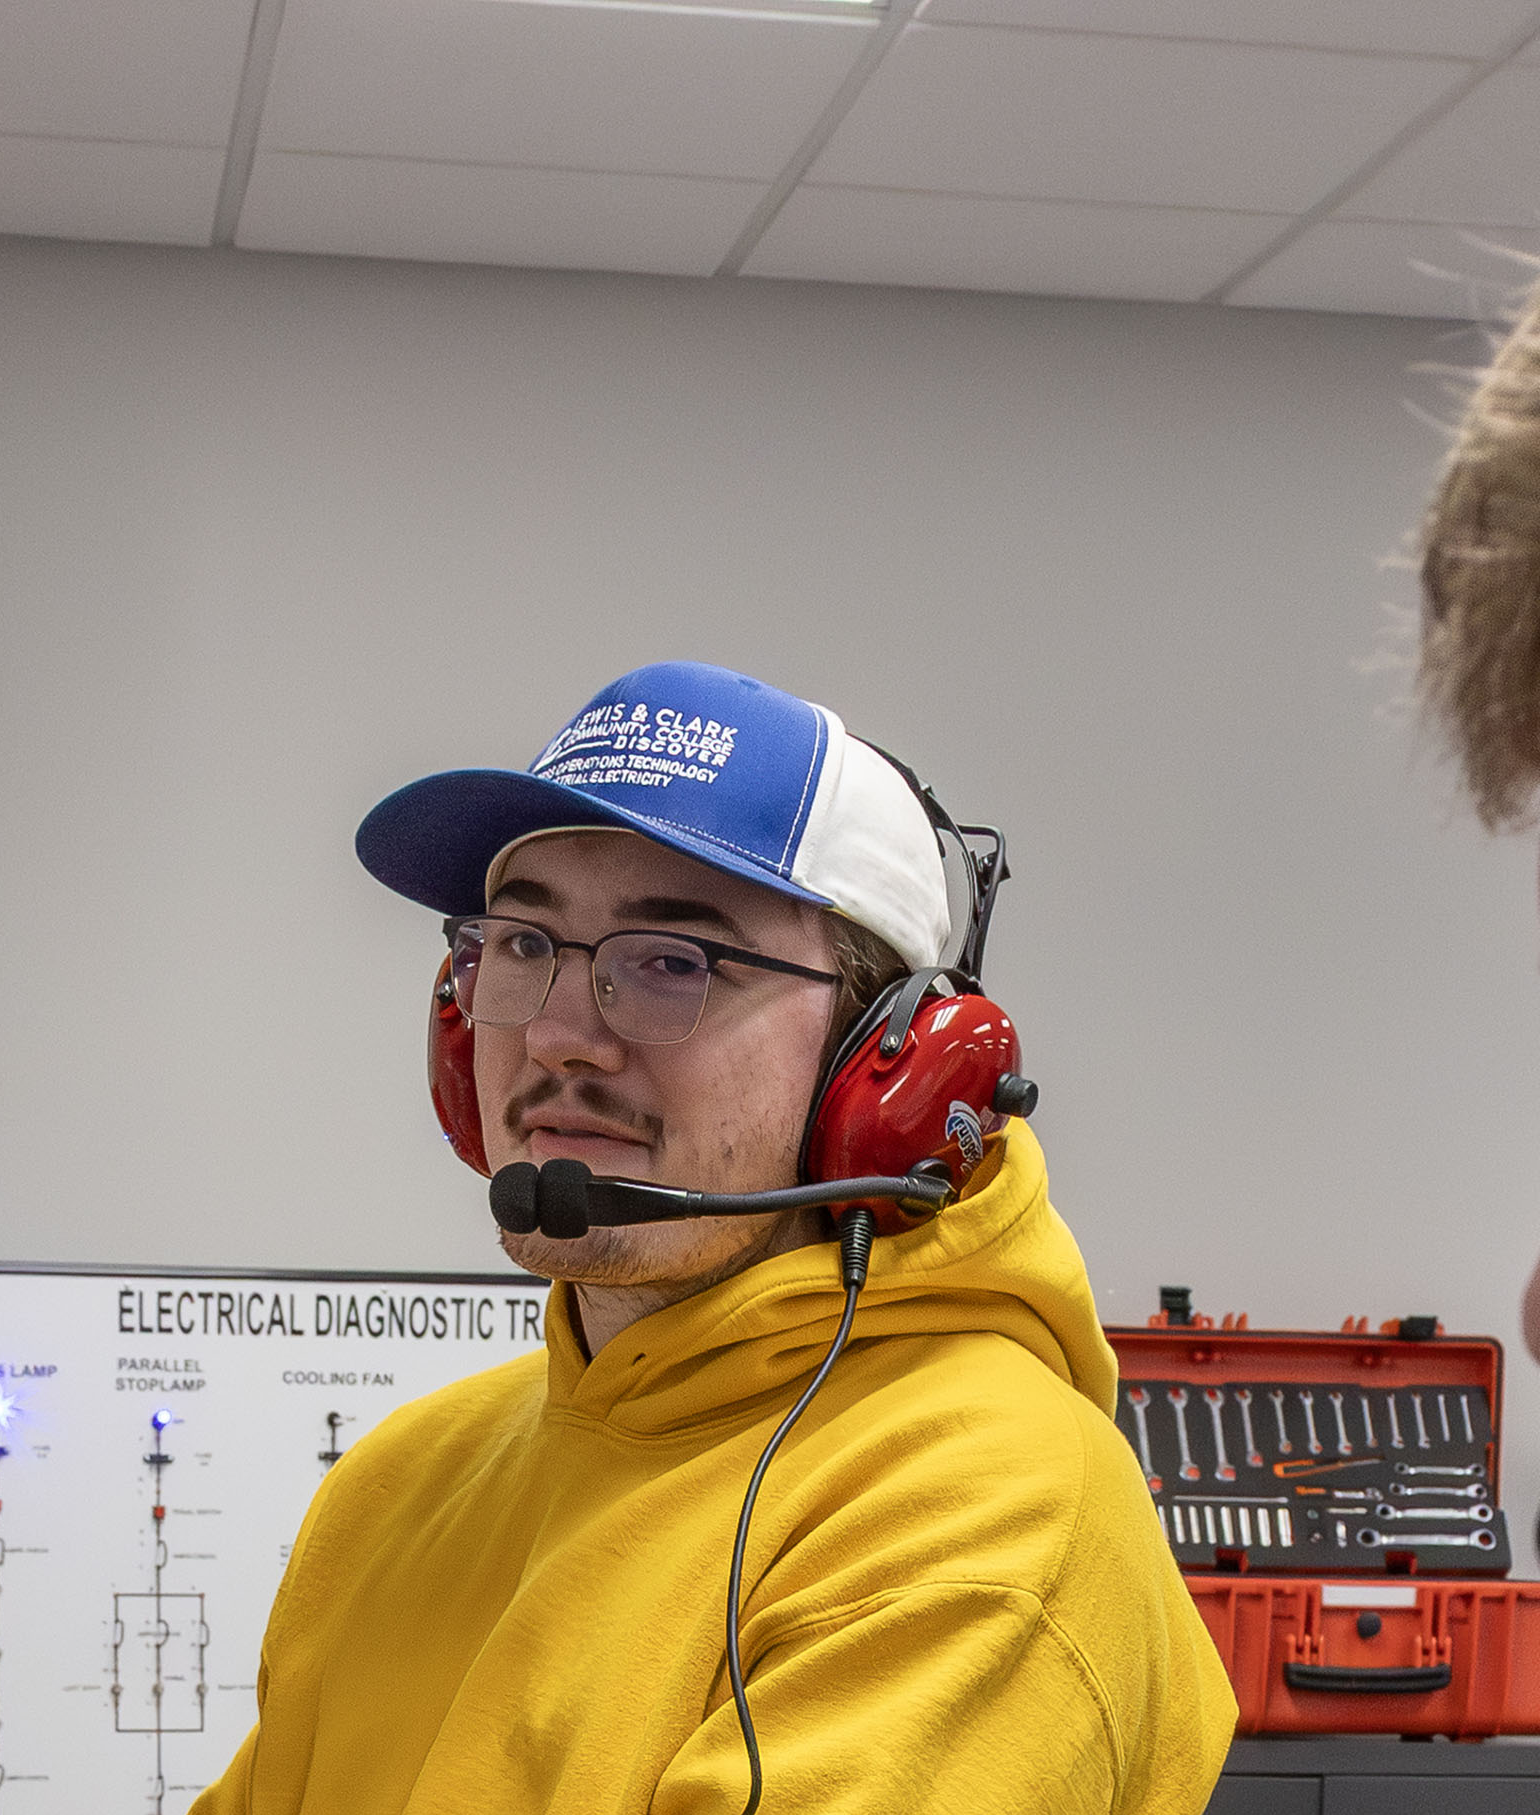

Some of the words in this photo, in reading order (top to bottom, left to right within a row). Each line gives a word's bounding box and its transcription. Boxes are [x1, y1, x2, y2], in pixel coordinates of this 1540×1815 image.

[575, 703, 626, 729] LEWIS
[631, 703, 648, 722] &
[655, 708, 738, 743] CLARK
[563, 722, 651, 748] COMMUNITY
[655, 726, 735, 757] COLLEGE
[613, 735, 728, 767] DISCOVER
[555, 754, 627, 777] OPERATIONS
[628, 754, 719, 784] TECHNOLOGY
[589, 769, 673, 788] ELECTRICITY
[117, 1290, 305, 1337] ELECTRICAL
[315, 1294, 495, 1340] DIAGNOSTIC
[506, 1299, 546, 1341] TR
[10, 1363, 58, 1379] LAMP
[118, 1357, 204, 1374] PARALLEL
[115, 1376, 207, 1393] STOPLAMP
[282, 1370, 357, 1387] COOLING
[362, 1371, 395, 1387] FAN
